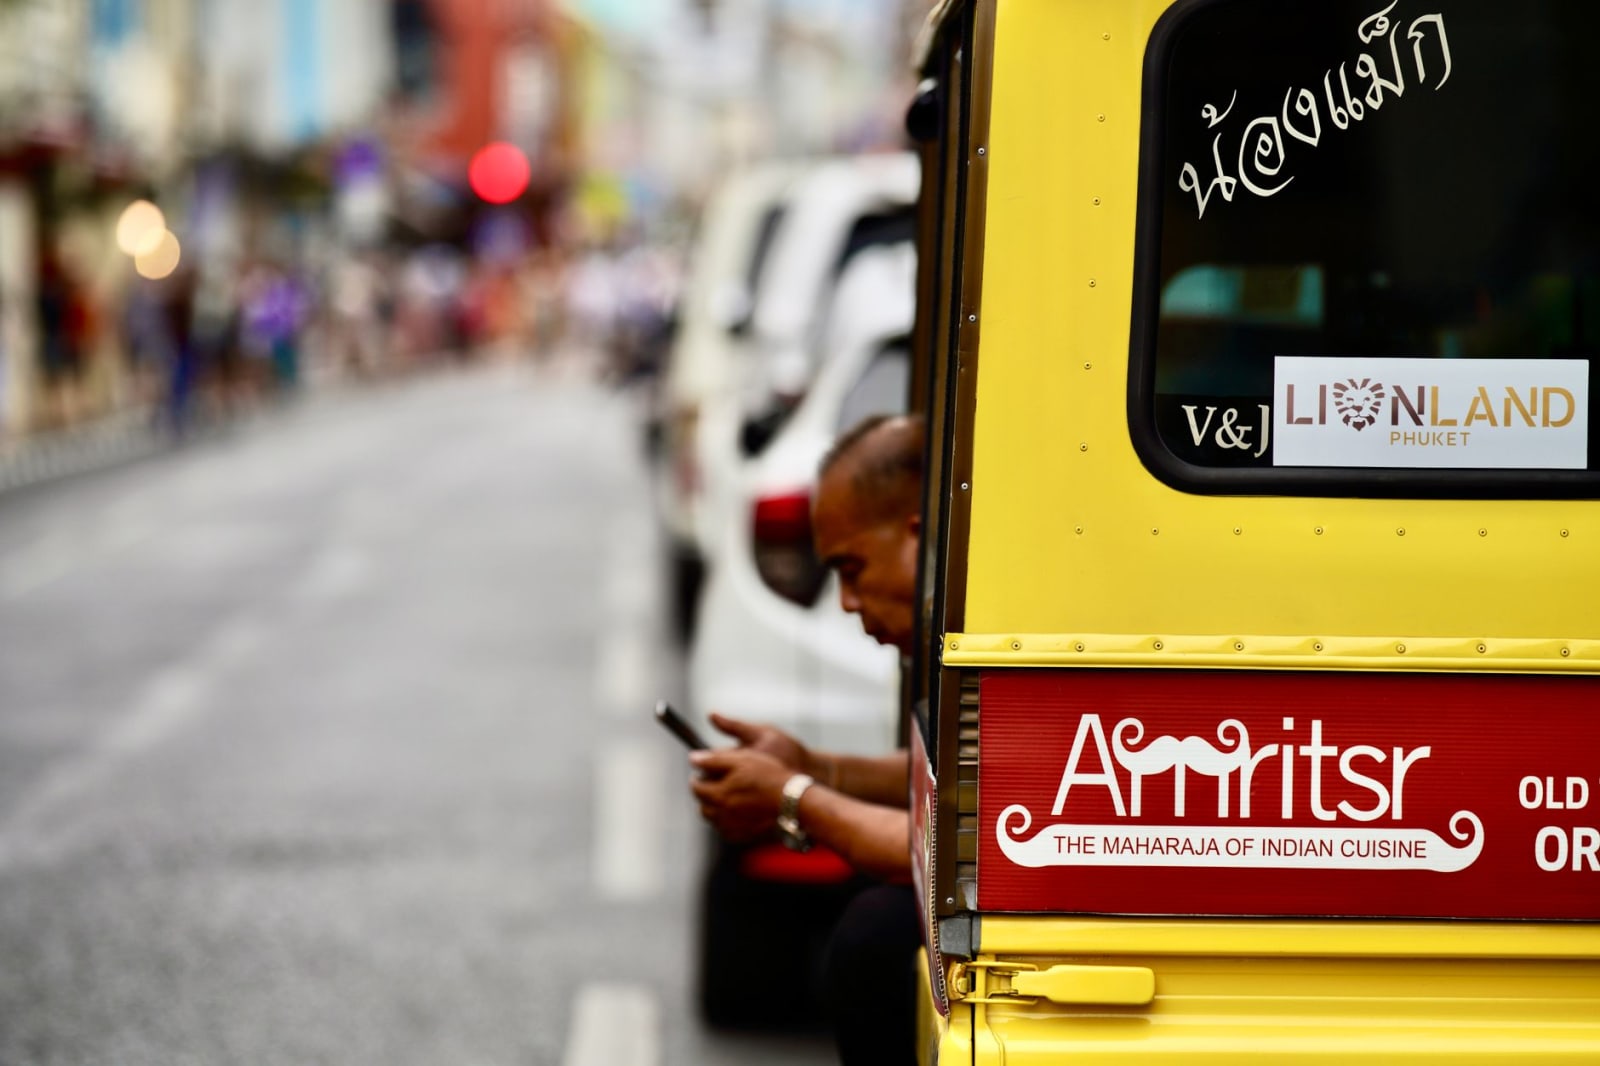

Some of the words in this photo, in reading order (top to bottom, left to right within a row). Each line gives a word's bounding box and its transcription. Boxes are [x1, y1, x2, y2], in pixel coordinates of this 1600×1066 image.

[1178, 0, 1452, 219] น้องแม็ก
[1181, 404, 1270, 458] V&J
[1390, 431, 1471, 447] PHUKET
[1050, 713, 1431, 822] Amritsr
[1518, 775, 1589, 810] OLD
[1053, 835, 1096, 855] THE
[1102, 836, 1220, 856] MAHARAJA
[1225, 837, 1255, 856] OF
[1261, 838, 1334, 858] INDIAN
[1339, 839, 1428, 859] CUISINE
